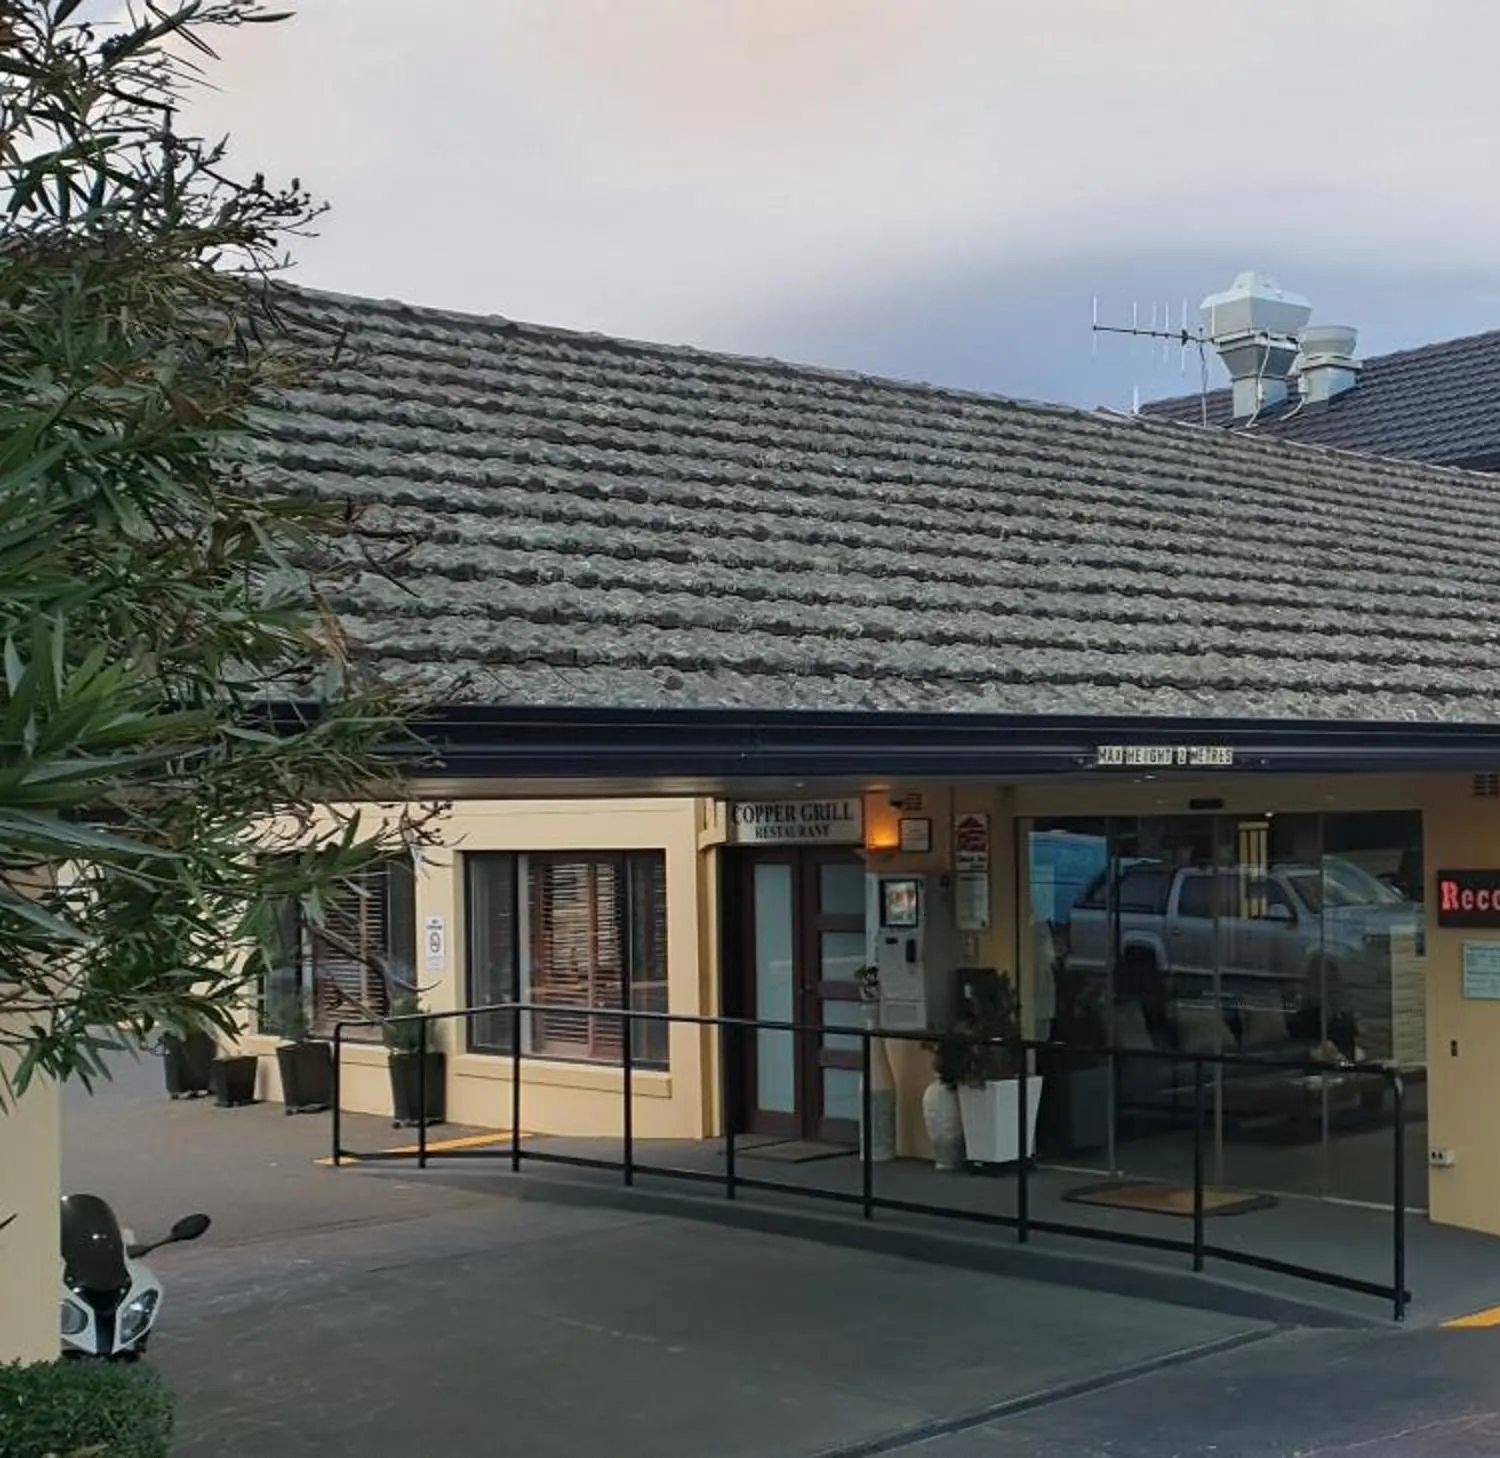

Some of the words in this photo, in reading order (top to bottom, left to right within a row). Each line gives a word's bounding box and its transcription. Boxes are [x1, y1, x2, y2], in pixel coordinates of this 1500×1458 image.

[732, 803, 796, 825] COPPER
[801, 801, 854, 821] GRILL
[755, 823, 830, 839] RESTAURANT
